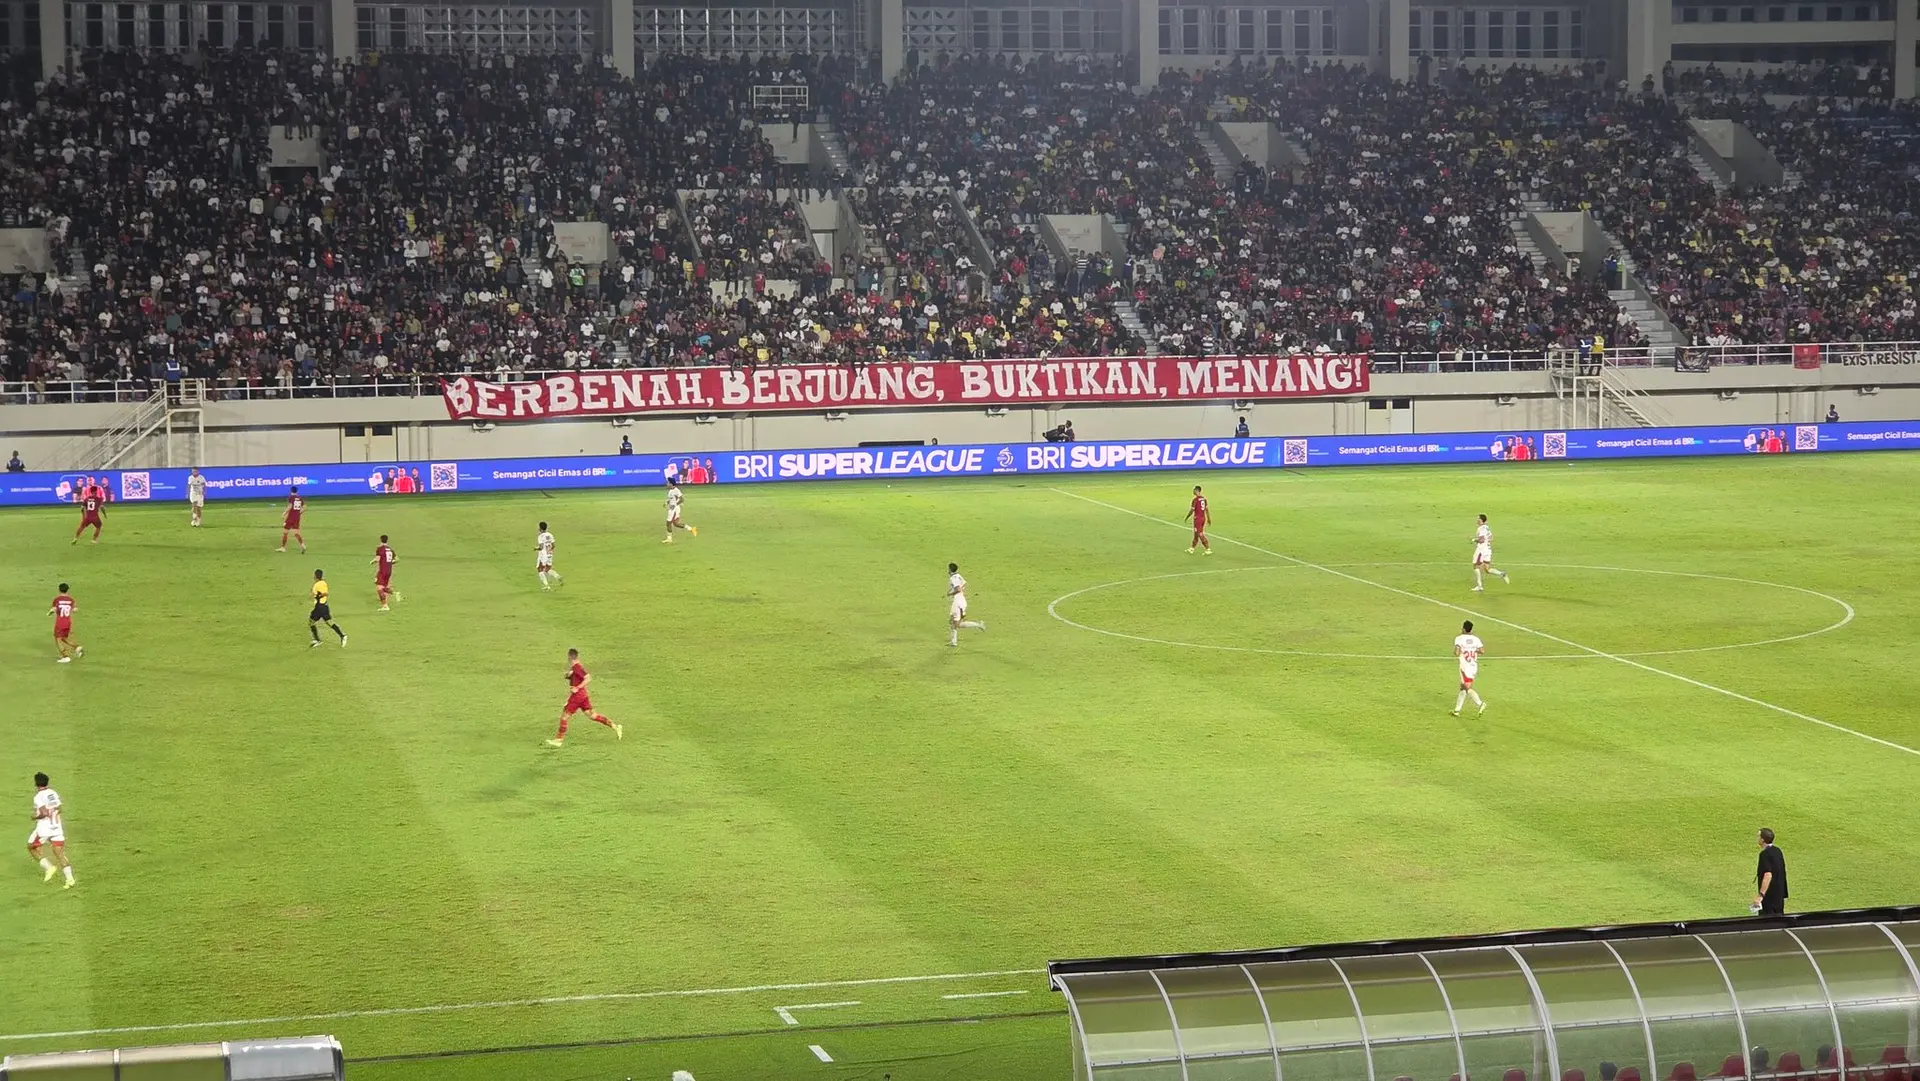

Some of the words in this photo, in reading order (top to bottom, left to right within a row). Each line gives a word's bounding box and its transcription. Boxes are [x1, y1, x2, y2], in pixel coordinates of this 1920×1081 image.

[446, 373, 714, 416] BERBENAH,
[721, 366, 945, 405] BERJUANG,
[961, 361, 1167, 398] BUKTIKAN,
[1177, 358, 1362, 395] MENANG!
[1847, 433, 1884, 441] Semangat
[1884, 431, 1901, 439] Cicil
[1597, 440, 1634, 448] Semangat
[1674, 437, 1682, 445] di
[1339, 446, 1377, 455] Semangat
[1379, 445, 1396, 453] Cicil
[1419, 444, 1426, 452] di
[1027, 446, 1064, 470] BRI
[734, 454, 773, 478] BRI
[493, 470, 537, 480] Semangat
[538, 469, 556, 477] Cicil
[558, 468, 581, 477] Emas
[582, 467, 591, 476] di
[235, 479, 255, 487] Cicil
[256, 477, 281, 486] Emas
[283, 476, 292, 485] di
[1463, 650, 1476, 662] 24
